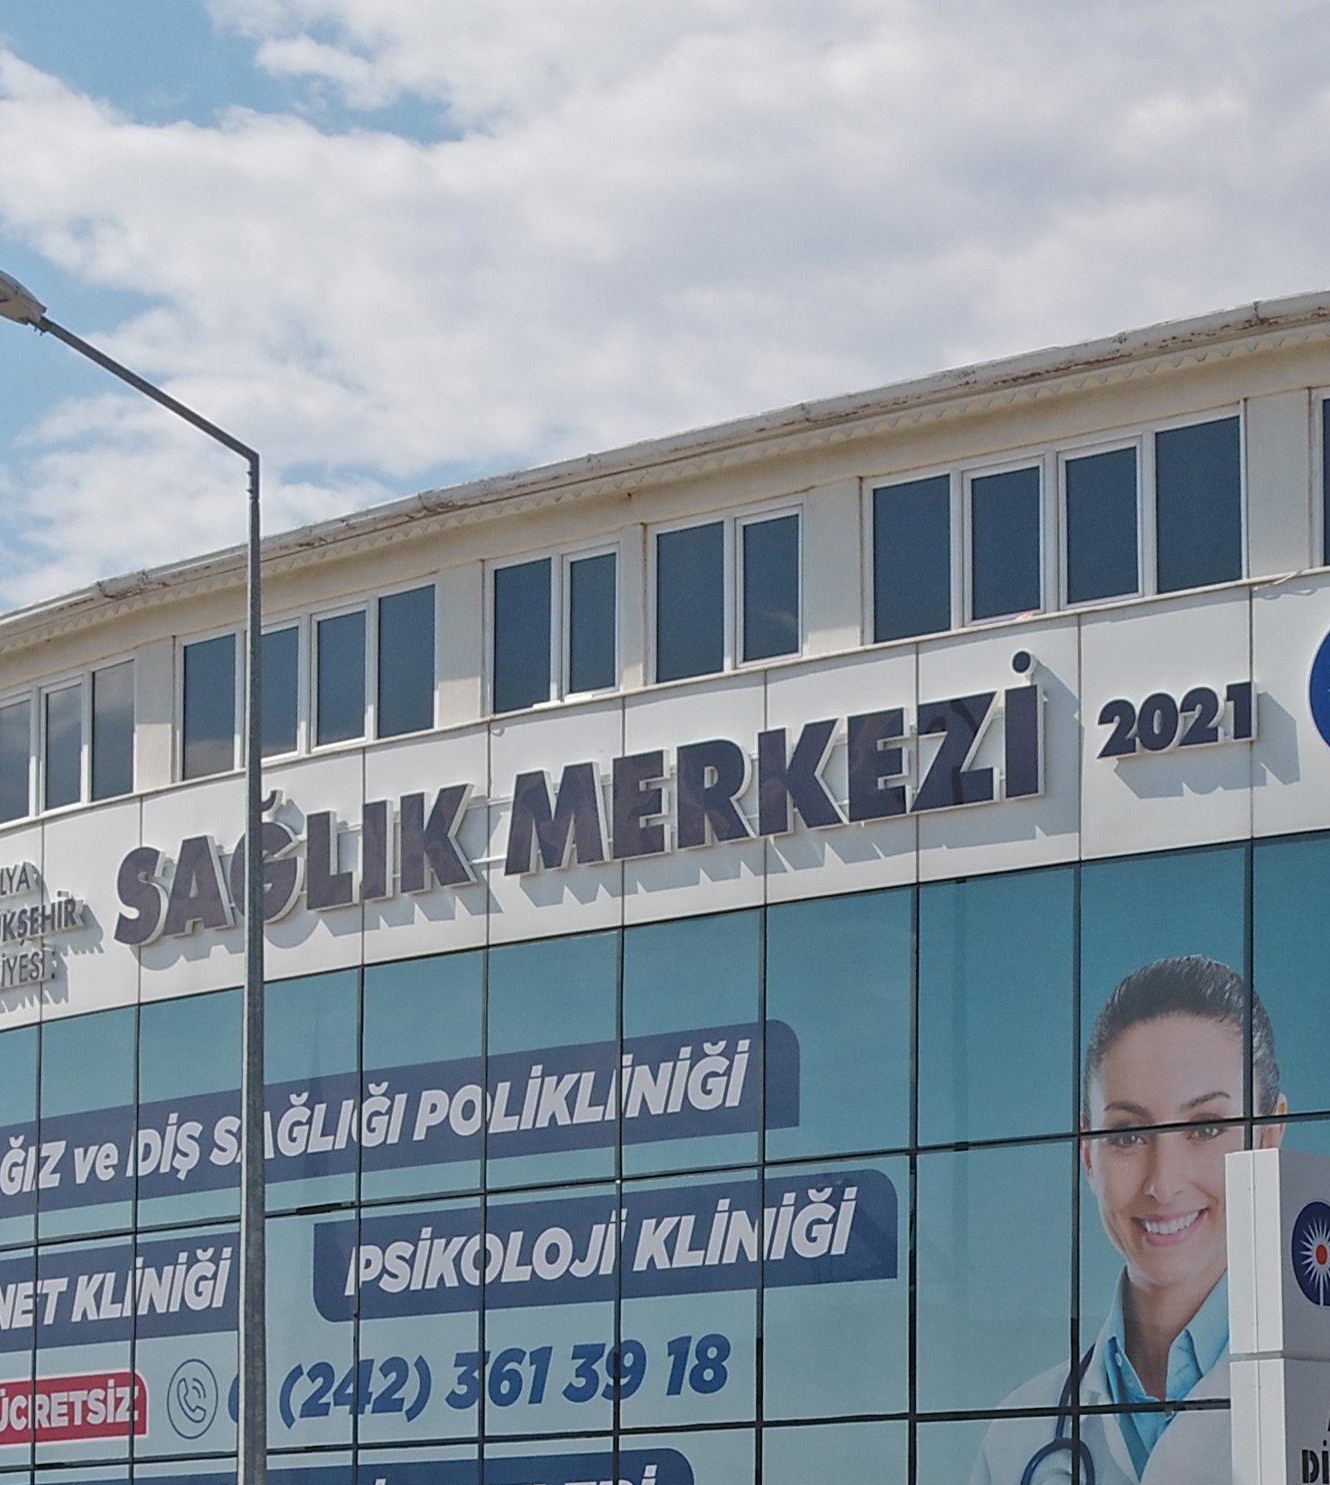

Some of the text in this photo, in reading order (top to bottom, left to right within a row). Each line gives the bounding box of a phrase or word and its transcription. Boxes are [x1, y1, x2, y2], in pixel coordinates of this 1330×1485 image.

[114, 649, 1259, 947] SAĞLIK MERKEZİ 2021
[73, 1143, 119, 1184] ve
[126, 1112, 203, 1181] DİŞ
[413, 1038, 751, 1141] POLİKLİNİĞİ
[71, 1246, 232, 1323] KLİNİĞİ
[344, 1186, 858, 1296] PSİKOLOJİ KLİNİĞİ
[279, 1356, 432, 1430] (242)
[445, 1345, 552, 1411] 361
[562, 1339, 648, 1403] 39
[665, 1333, 733, 1396] 18
